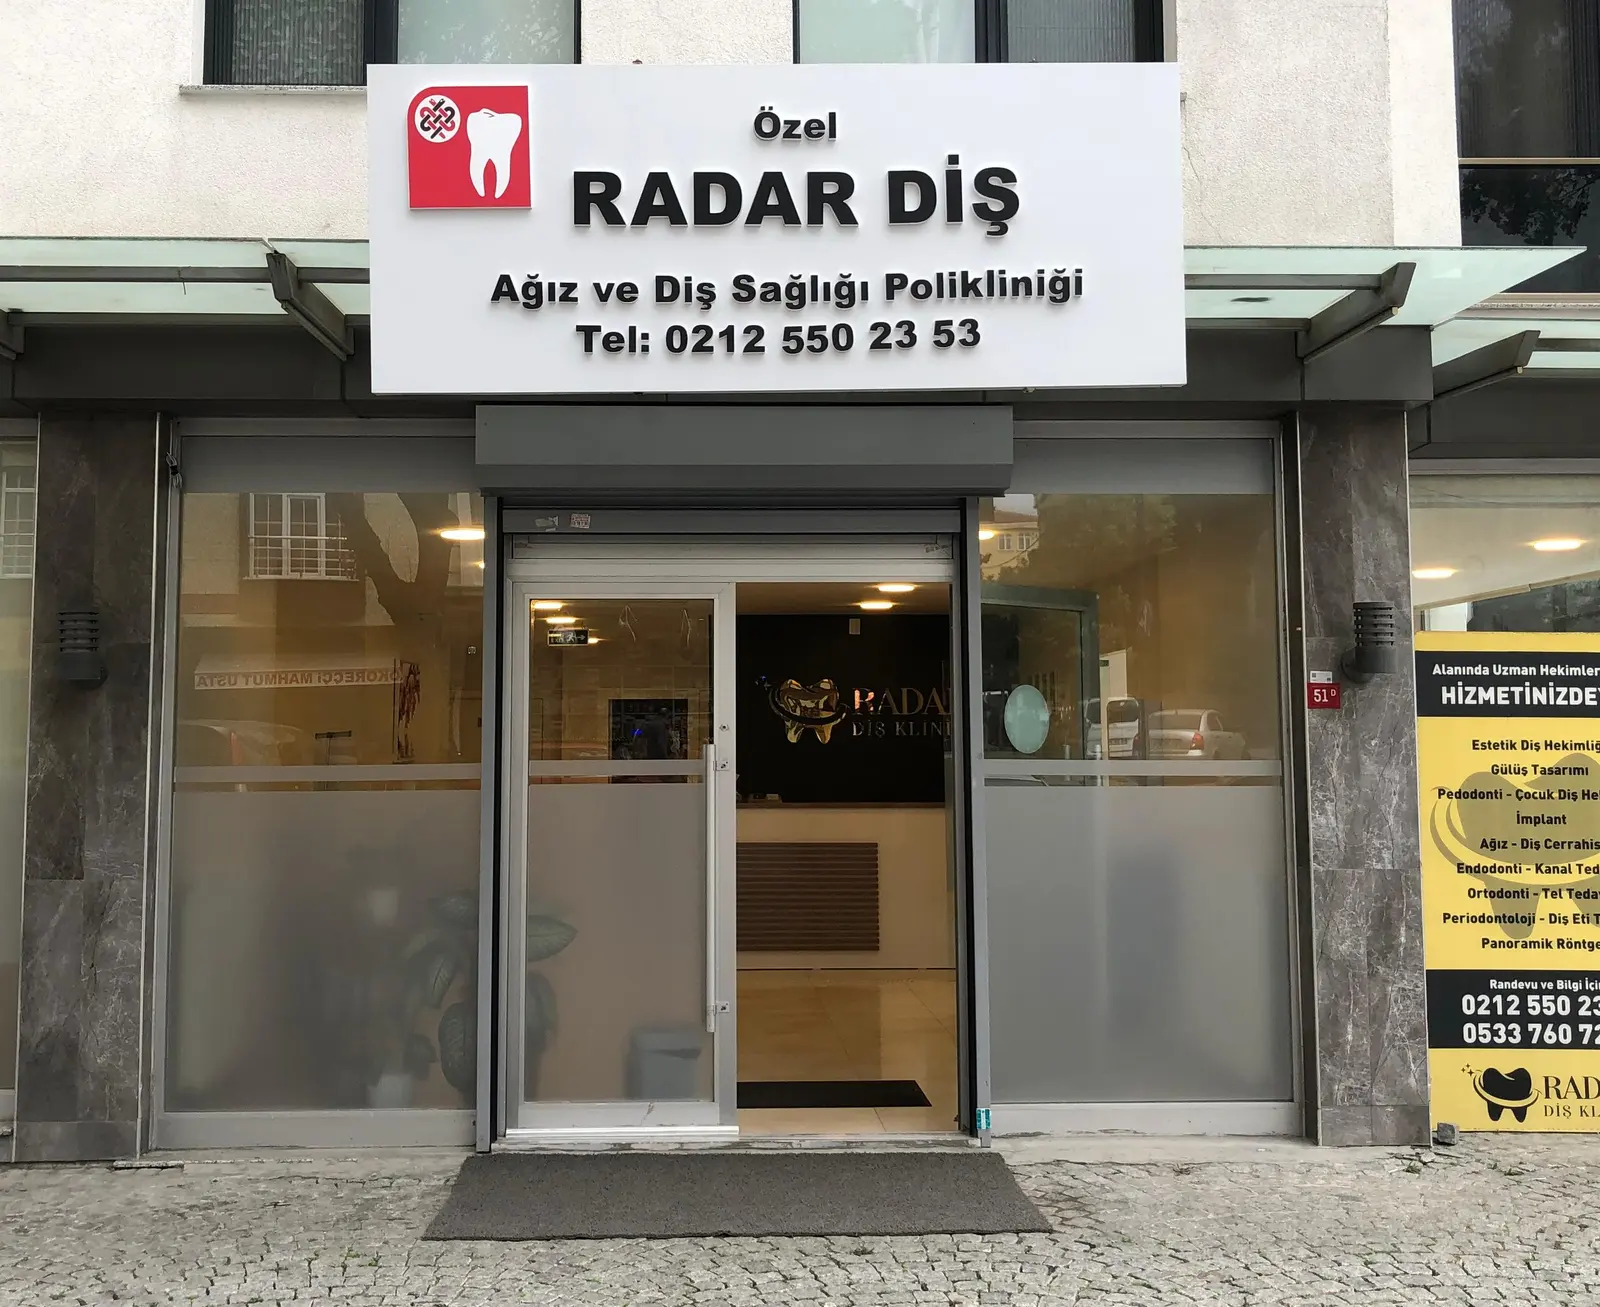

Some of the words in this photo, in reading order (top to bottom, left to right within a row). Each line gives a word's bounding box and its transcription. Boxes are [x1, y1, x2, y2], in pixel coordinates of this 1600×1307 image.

[754, 106, 837, 141] Özel
[573, 171, 859, 228] RADAR
[888, 155, 1020, 237] DİŞ
[491, 274, 579, 309] Ağız
[593, 282, 639, 303] ve
[656, 275, 716, 310] Diş
[732, 273, 869, 309] Sağlığı
[886, 268, 1083, 304] Polikliniği
[576, 325, 649, 353] Tel:
[666, 323, 765, 355] 0212
[782, 323, 853, 354] 550
[870, 320, 916, 350] 23
[933, 318, 980, 348] 53
[1433, 663, 1490, 676] Alanında
[1493, 664, 1537, 676] Uzman
[852, 687, 950, 715] RADA
[1313, 689, 1328, 702] 51
[1441, 681, 1600, 706] HİZMETİNİZDE
[1472, 739, 1517, 751] Estetik
[1521, 739, 1541, 753] Diş
[1491, 763, 1528, 777] Gülüş
[1531, 764, 1589, 776] Tasarımı
[1438, 788, 1502, 800] Pedodonti
[1515, 788, 1555, 802] Çocuk
[1558, 789, 1578, 803] Diş
[1582, 789, 1600, 801] He
[1516, 810, 1567, 827] İmplant
[1480, 838, 1508, 853] Ağız
[1521, 838, 1541, 852] Diş
[1457, 862, 1522, 875] Endodonti
[1535, 862, 1573, 875] Kanal
[1467, 887, 1530, 900] Ortodonti
[1542, 887, 1563, 900] Tel
[1566, 888, 1600, 900] Teda
[1443, 912, 1536, 927] Periodontoloji
[1548, 913, 1569, 926] Diş
[1573, 913, 1590, 925] Eti
[1482, 937, 1553, 950] Panoramik
[1490, 979, 1538, 990] Randevu
[1541, 981, 1554, 990] ve
[1557, 979, 1583, 992] Bilgi
[1461, 994, 1521, 1016] 0212
[1527, 994, 1571, 1016] 550
[1462, 1022, 1522, 1044] 0533
[1527, 1023, 1572, 1045] 760
[1543, 1075, 1600, 1100] RAD
[1544, 1102, 1572, 1119] DİŞ
